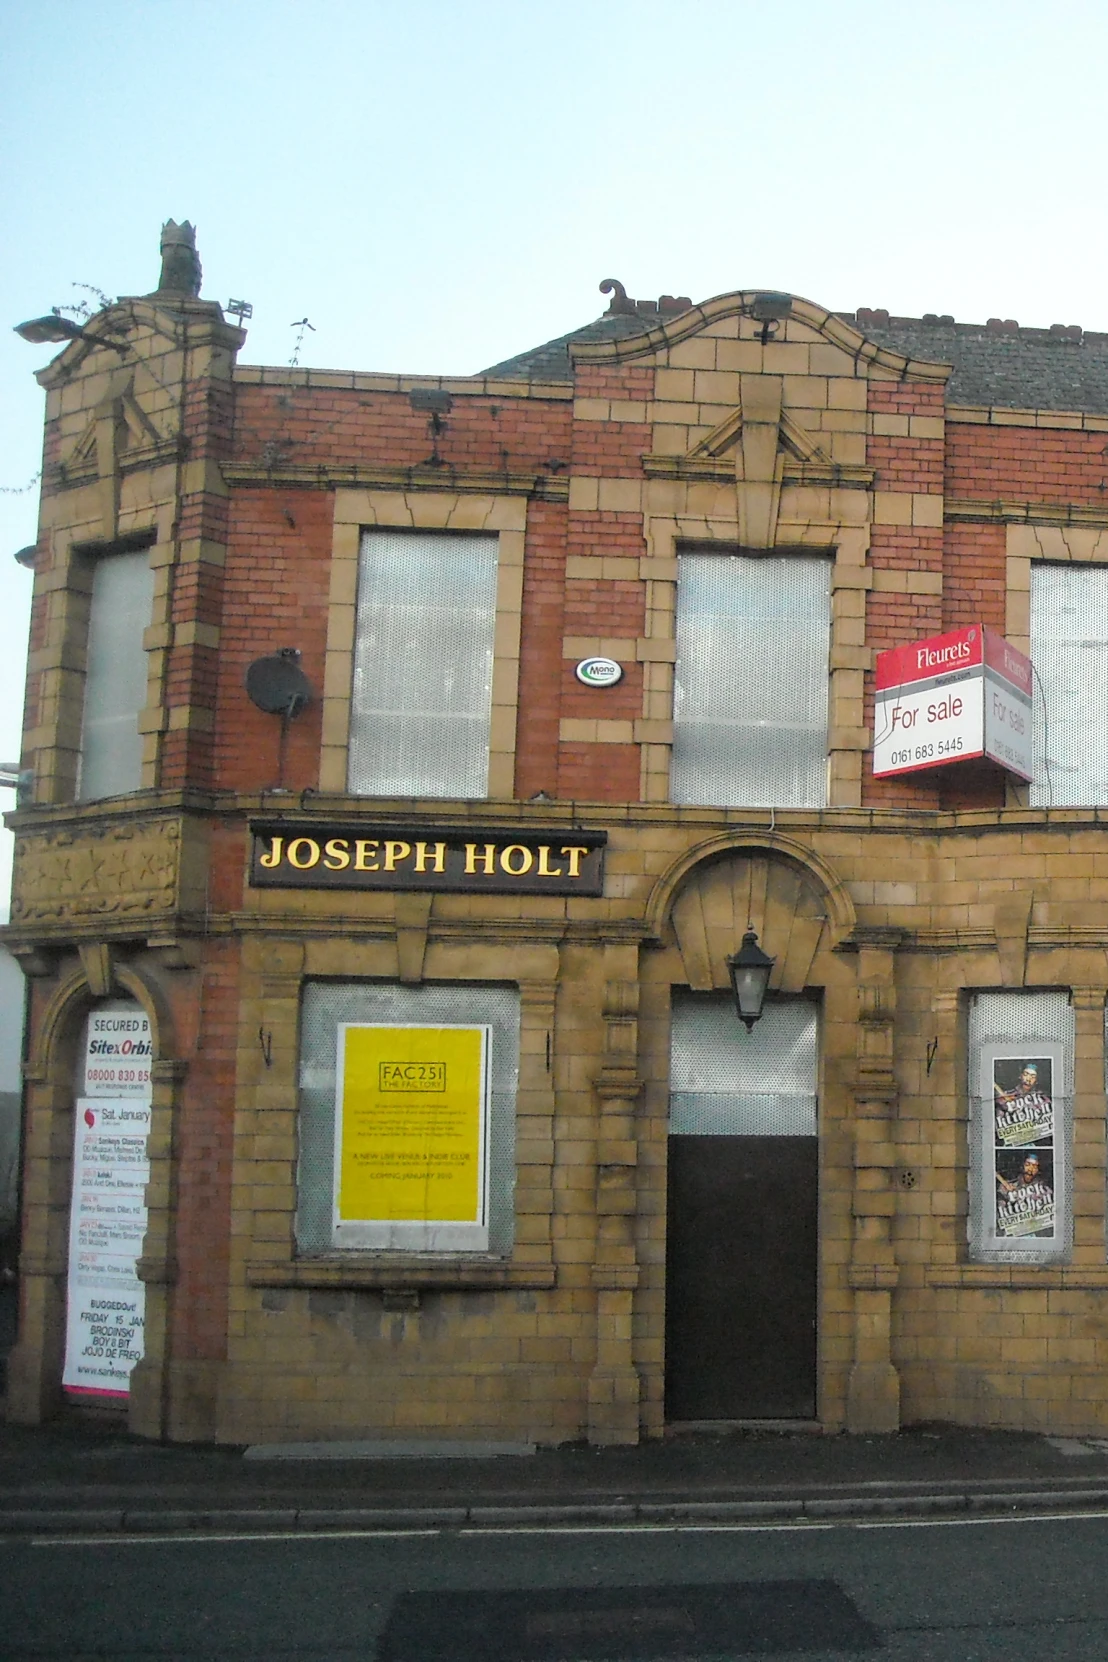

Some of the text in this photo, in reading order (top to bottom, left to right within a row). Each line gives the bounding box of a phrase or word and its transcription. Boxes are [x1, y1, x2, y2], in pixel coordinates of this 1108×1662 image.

[917, 642, 971, 669] Fleurets
[589, 666, 615, 675] Mono
[892, 694, 963, 732] For sale
[993, 692, 1006, 722] For
[891, 737, 963, 765] 0161 683 5445
[260, 836, 588, 877] JOSEPH HOLT
[94, 1020, 140, 1032] SECURED
[87, 1069, 115, 1080] 08000
[118, 1070, 135, 1081] 830
[402, 1081, 441, 1089] FACTORY
[1006, 1093, 1044, 1112] rock
[119, 1109, 150, 1123] January
[996, 1103, 1051, 1128] kitchen
[369, 1172, 401, 1180] COMING
[402, 1172, 434, 1181] JANUARY
[1007, 1183, 1046, 1202] rock
[998, 1195, 1053, 1218] kitchen
[81, 1312, 109, 1323] FRIDAY
[115, 1315, 124, 1325] 15
[90, 1325, 135, 1338] BRODINSKI
[93, 1337, 110, 1346] BOY
[118, 1339, 132, 1349] BIT
[82, 1346, 103, 1357] JOJO
[105, 1348, 117, 1358] DE
